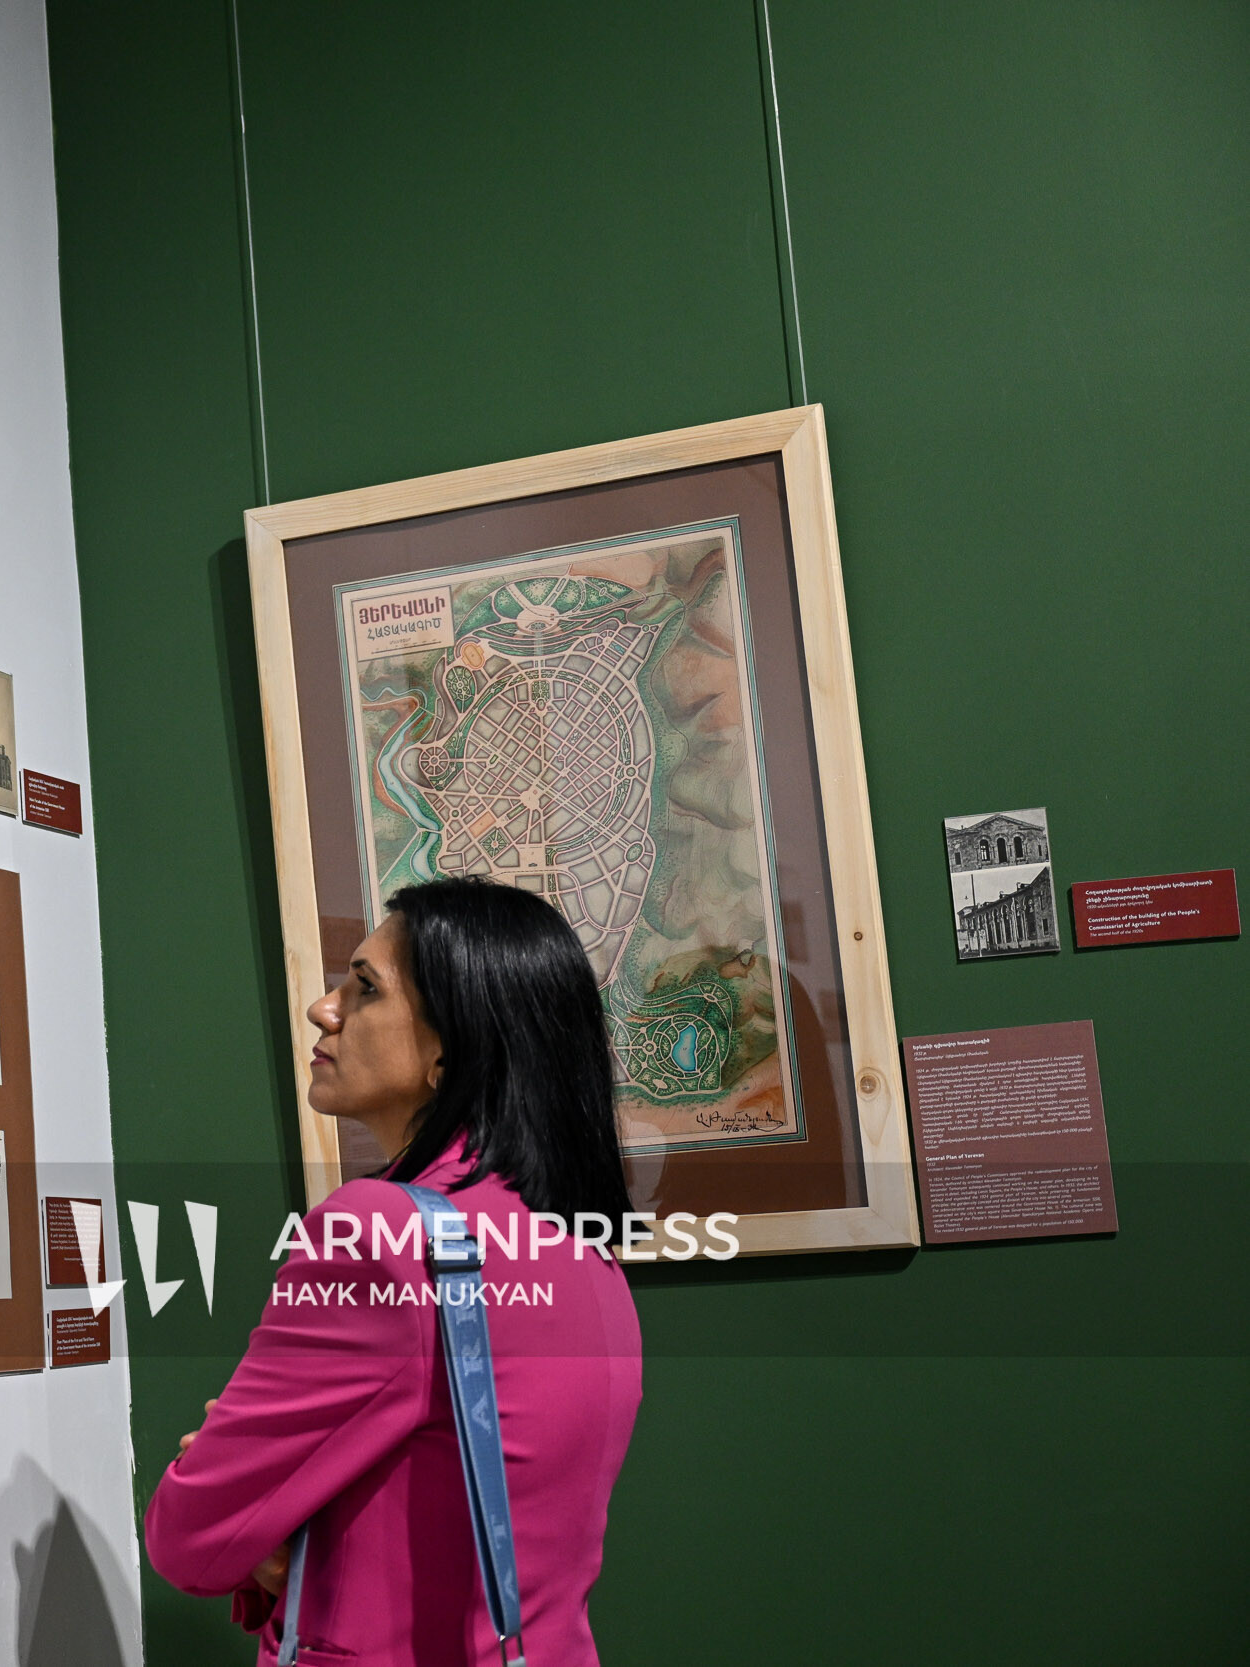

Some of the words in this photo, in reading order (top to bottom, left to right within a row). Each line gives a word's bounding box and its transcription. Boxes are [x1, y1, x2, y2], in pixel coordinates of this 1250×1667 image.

[359, 596, 446, 625] ՅԵՐԵՎԱՆԻ
[367, 618, 442, 641] ՀԱՏԱԿԱԳԻԾ
[1132, 920, 1161, 928] Agriculture
